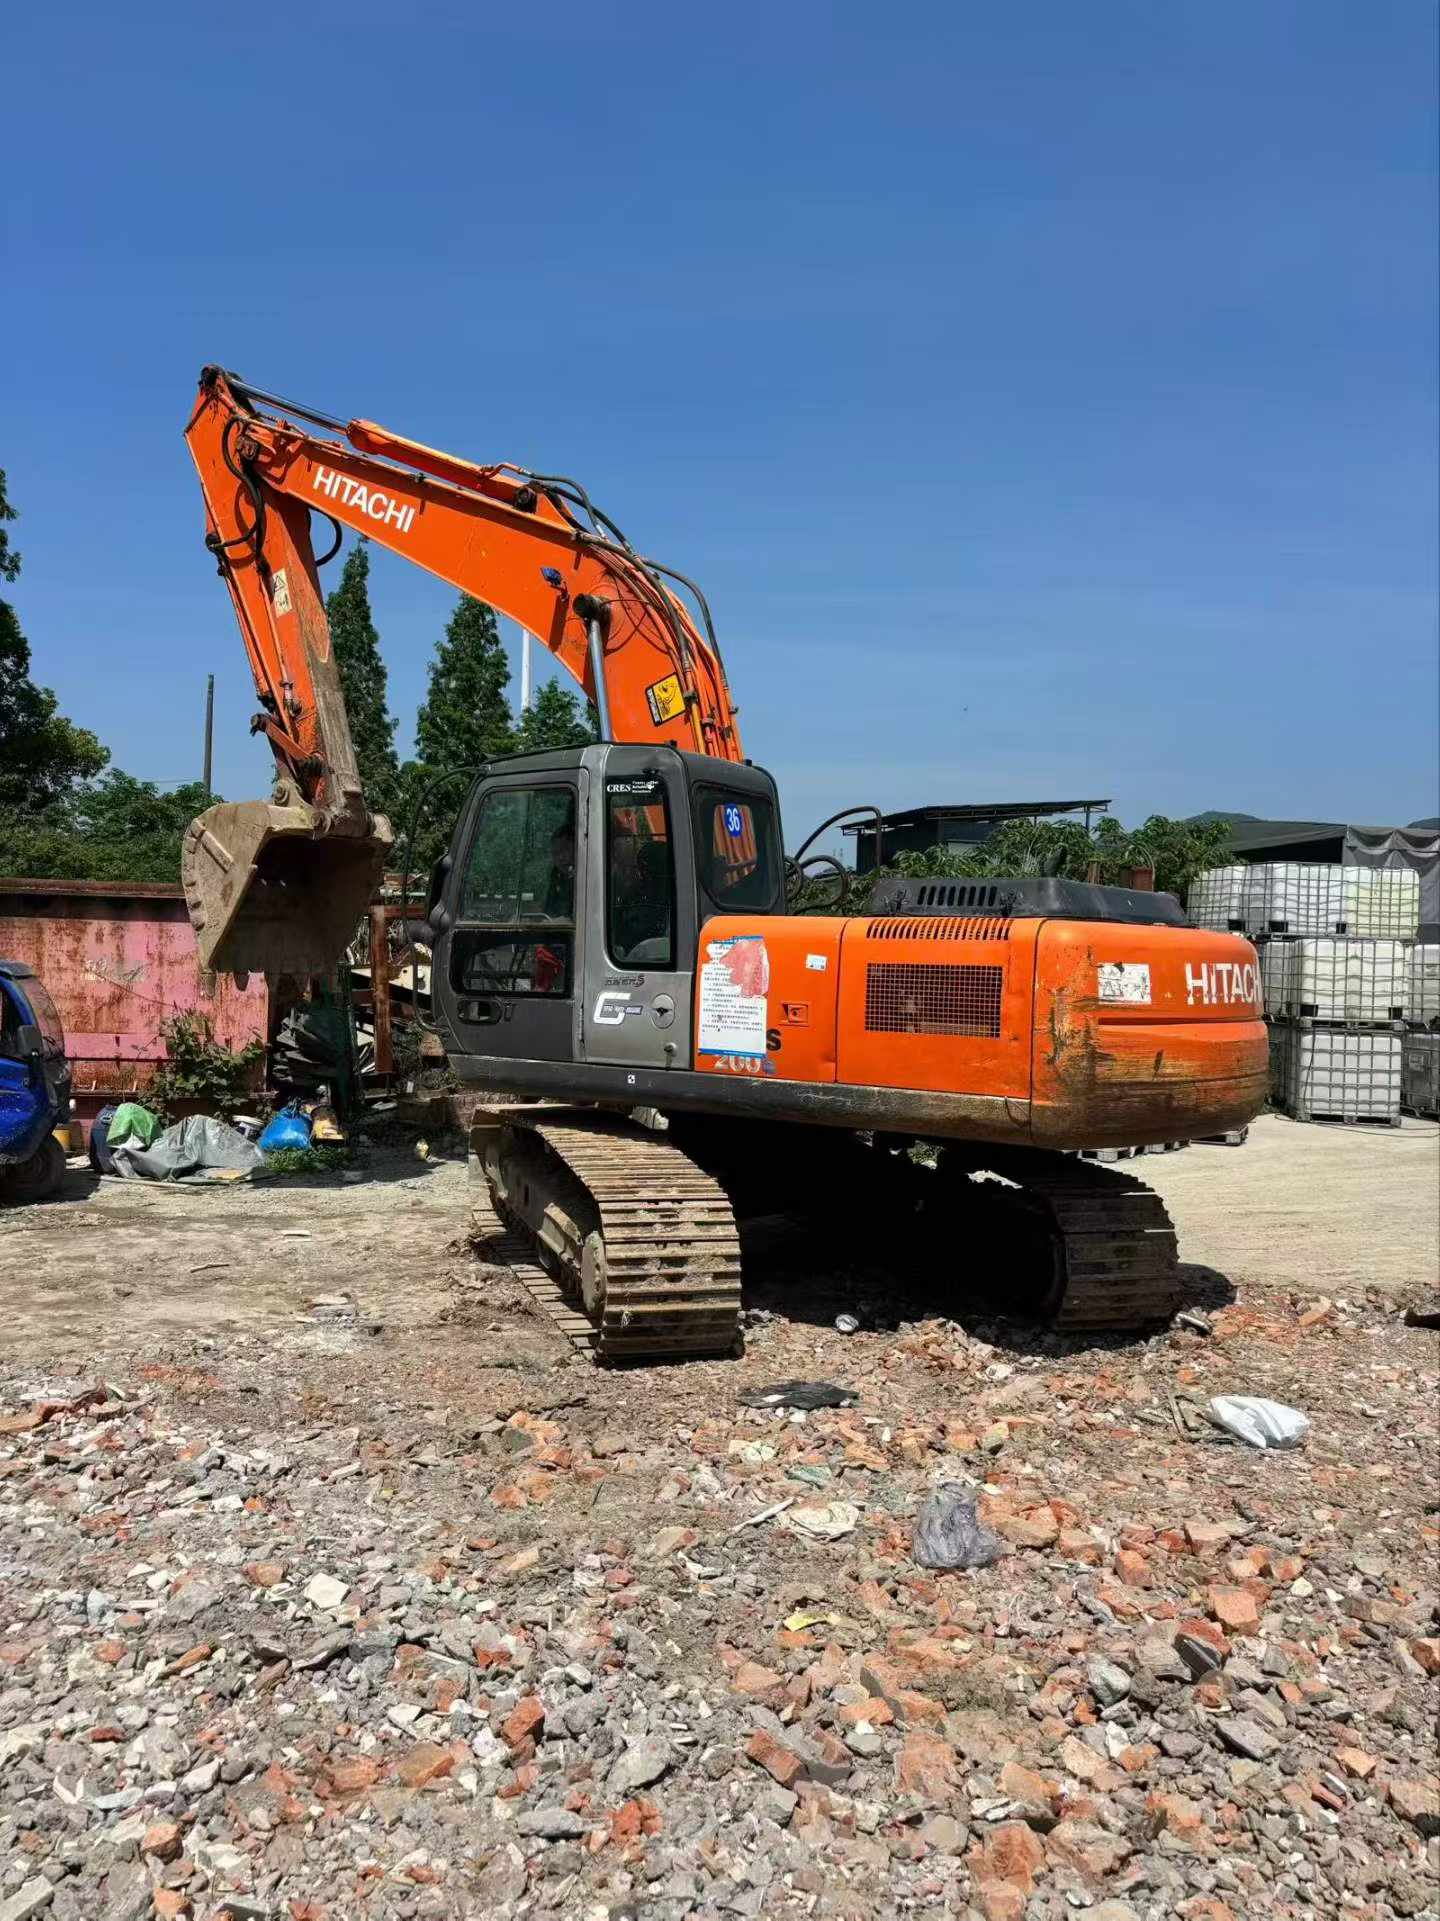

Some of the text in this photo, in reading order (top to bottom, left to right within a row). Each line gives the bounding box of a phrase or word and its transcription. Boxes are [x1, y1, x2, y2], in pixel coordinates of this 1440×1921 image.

[313, 466, 415, 533] HITACHI
[606, 783, 632, 793] CRES
[726, 807, 741, 832] 36
[1185, 962, 1263, 1005] HITACH
